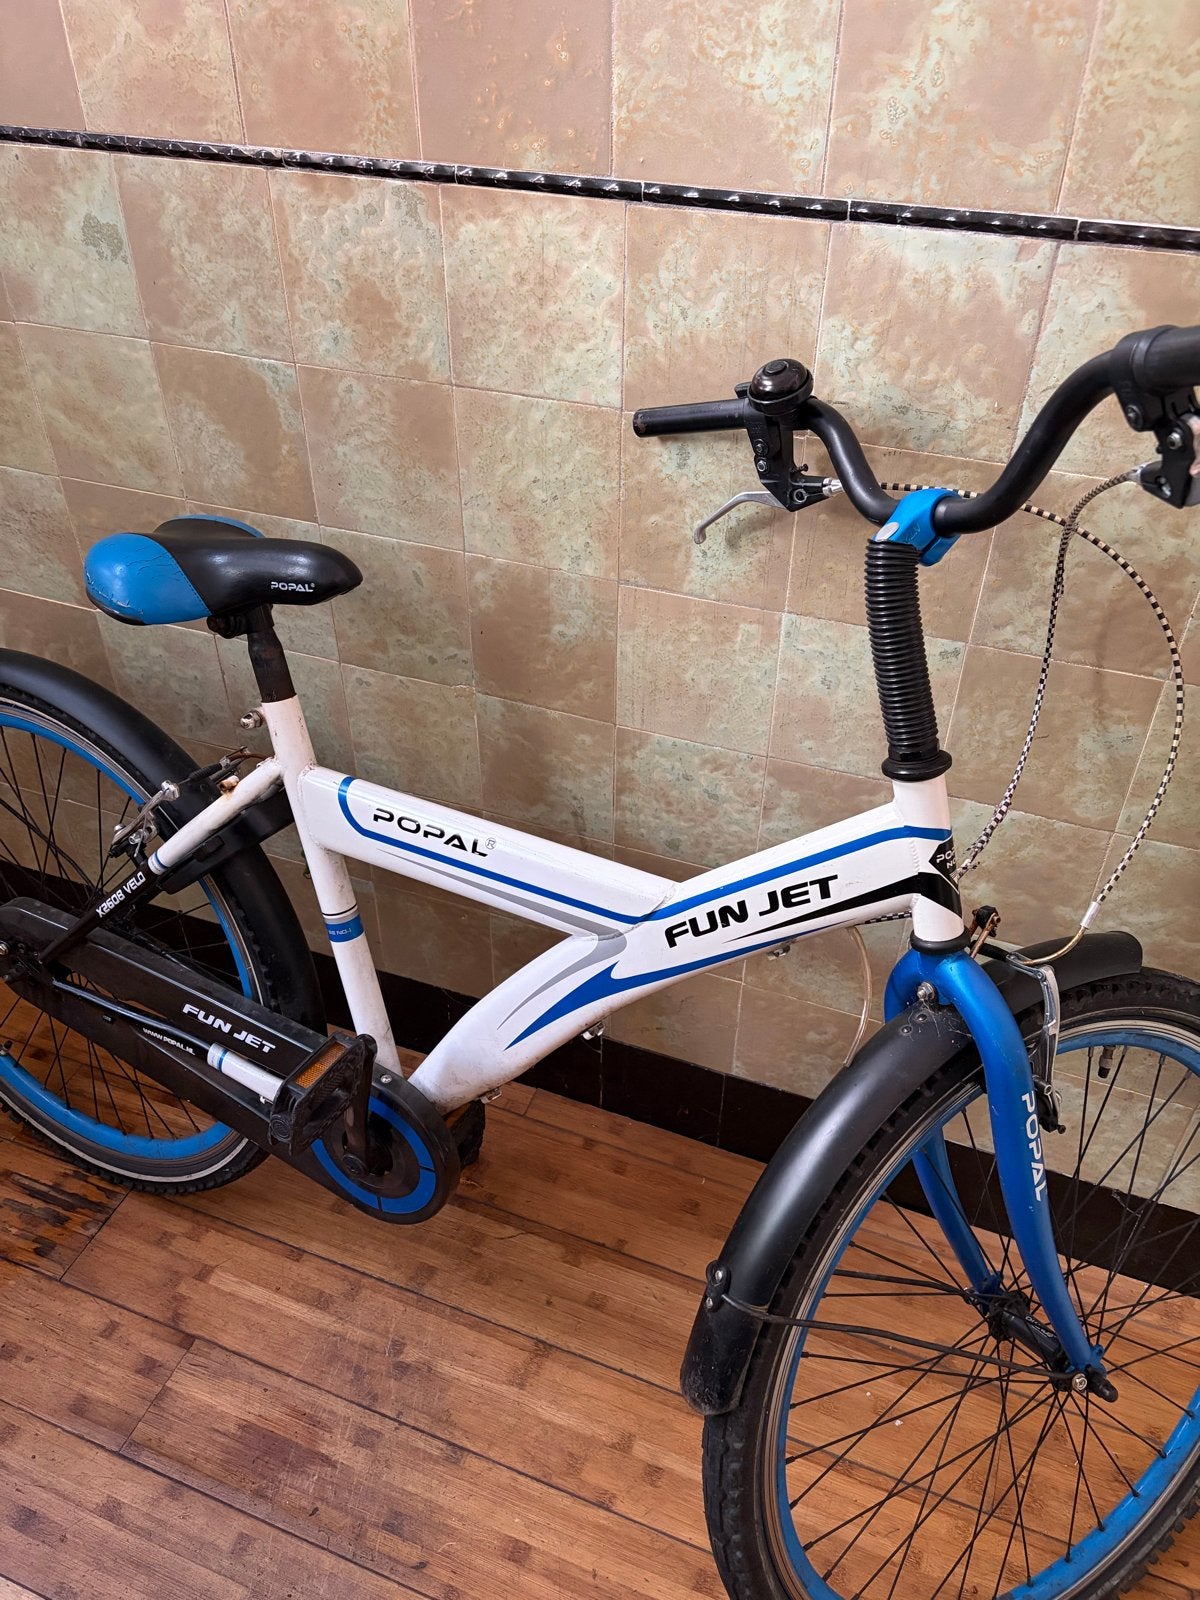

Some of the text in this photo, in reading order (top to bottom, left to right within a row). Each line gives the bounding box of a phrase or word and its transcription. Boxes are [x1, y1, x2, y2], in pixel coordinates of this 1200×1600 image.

[96, 871, 147, 918] X2608 VELO
[664, 874, 839, 949] FUN JET
[182, 1003, 277, 1054] FUN JET
[1021, 1090, 1047, 1202] POPAL
